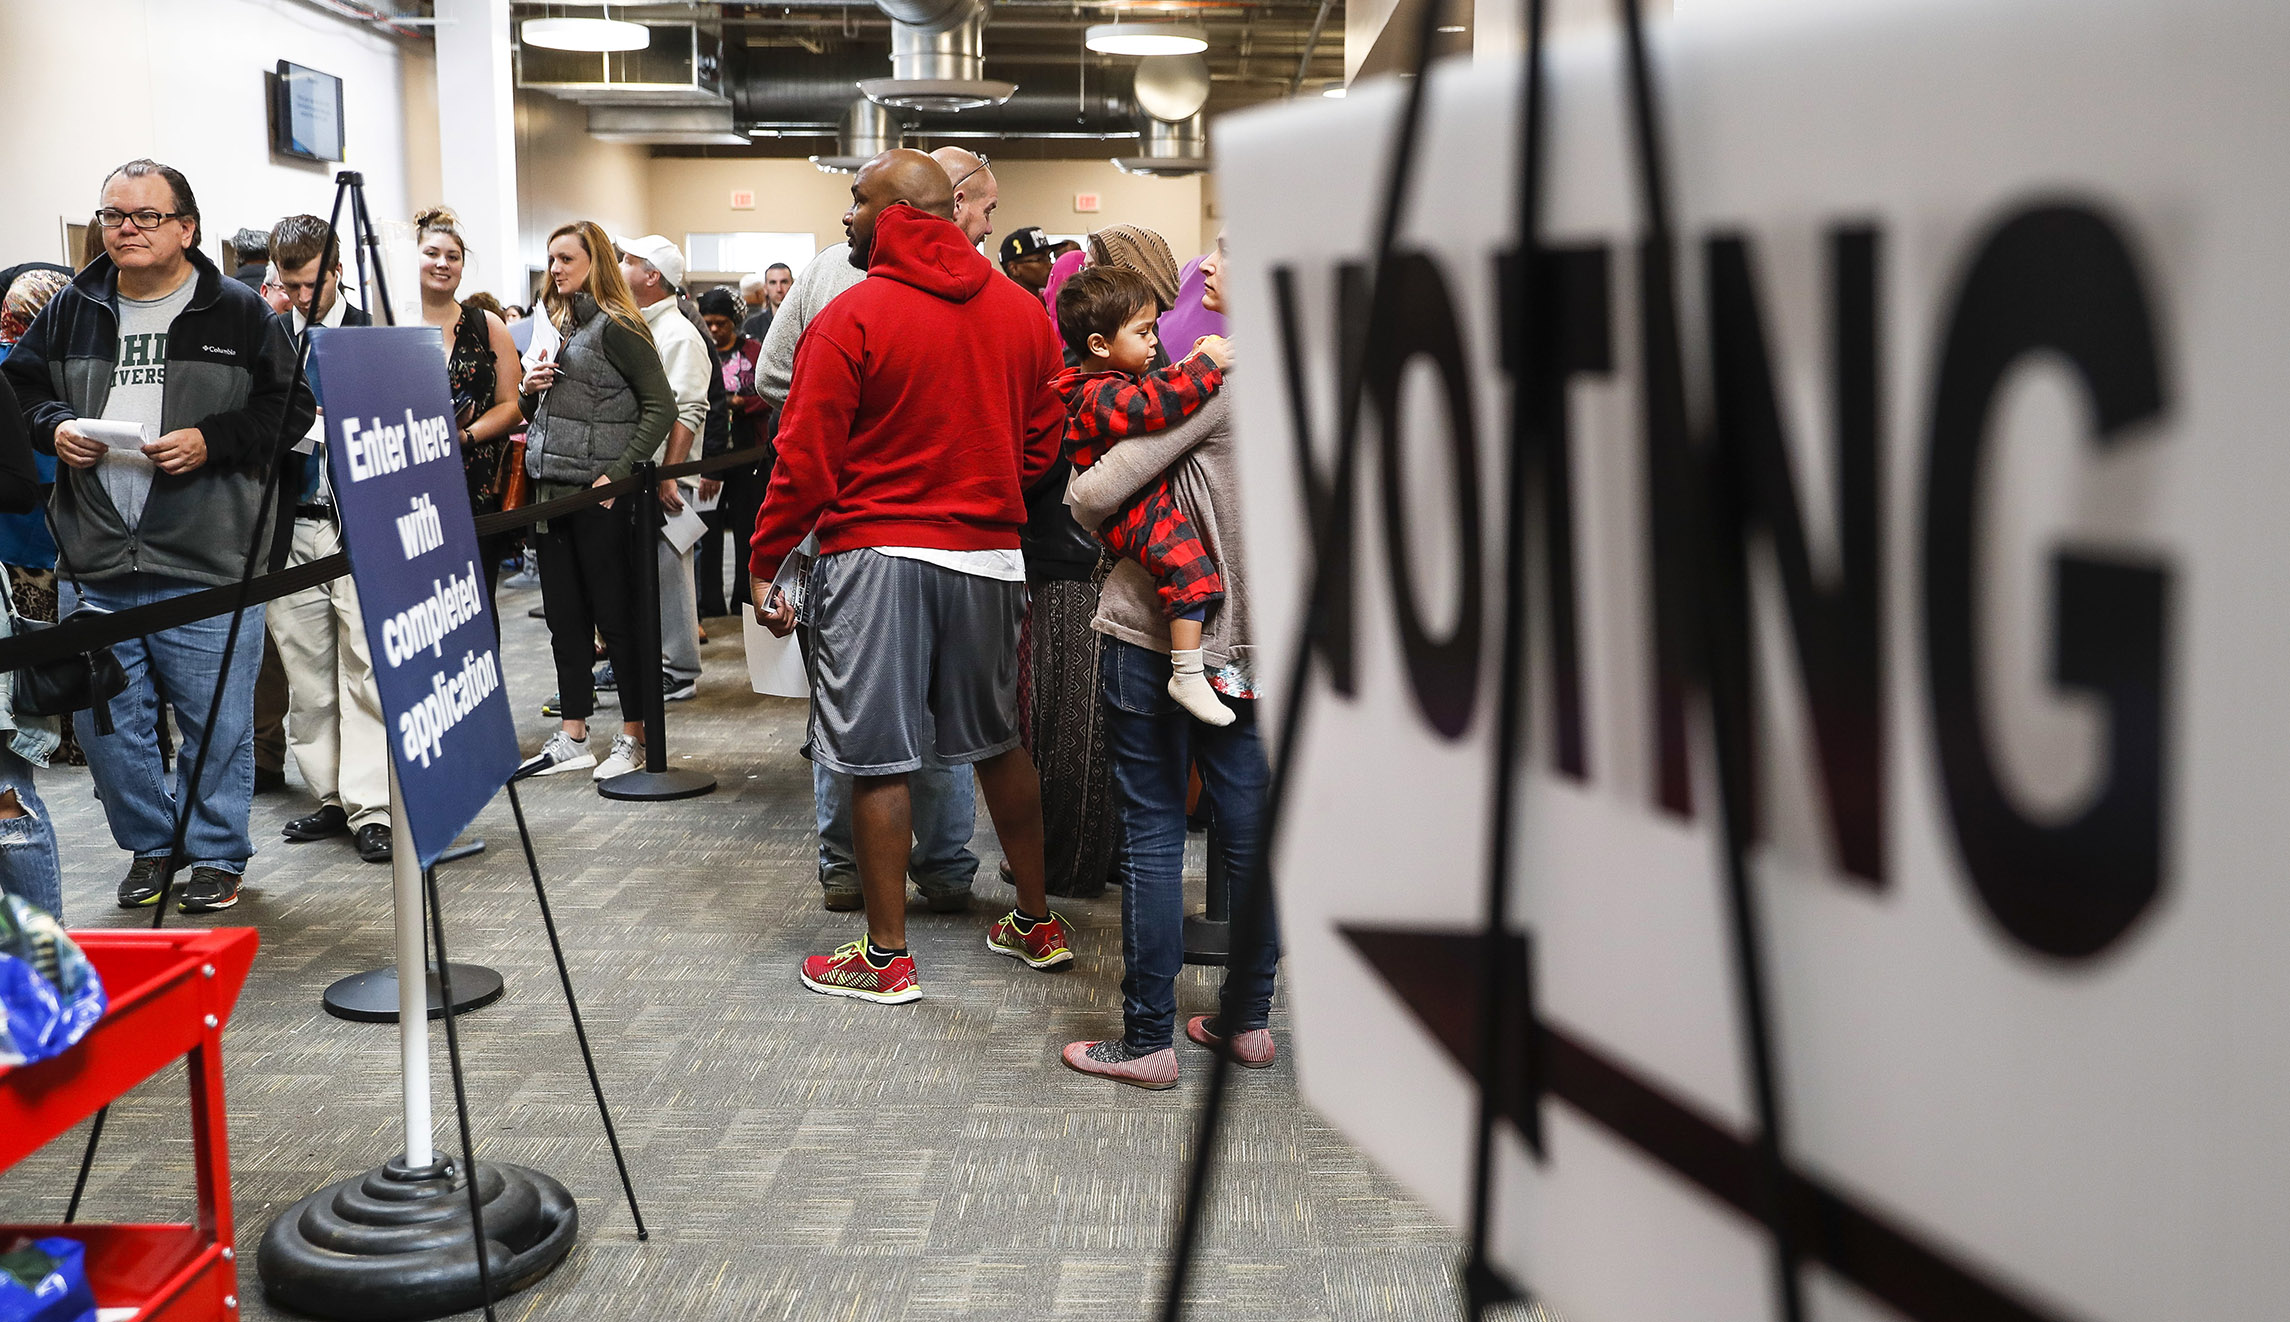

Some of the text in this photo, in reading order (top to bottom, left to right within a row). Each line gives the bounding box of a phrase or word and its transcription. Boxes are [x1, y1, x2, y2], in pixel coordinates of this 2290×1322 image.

[115, 332, 167, 367] HI
[208, 345, 237, 356] Columbia
[341, 408, 451, 483] Enter here
[396, 492, 444, 561] with
[382, 560, 482, 668] completed
[1266, 188, 2178, 972] VOTING
[398, 648, 500, 769] application
